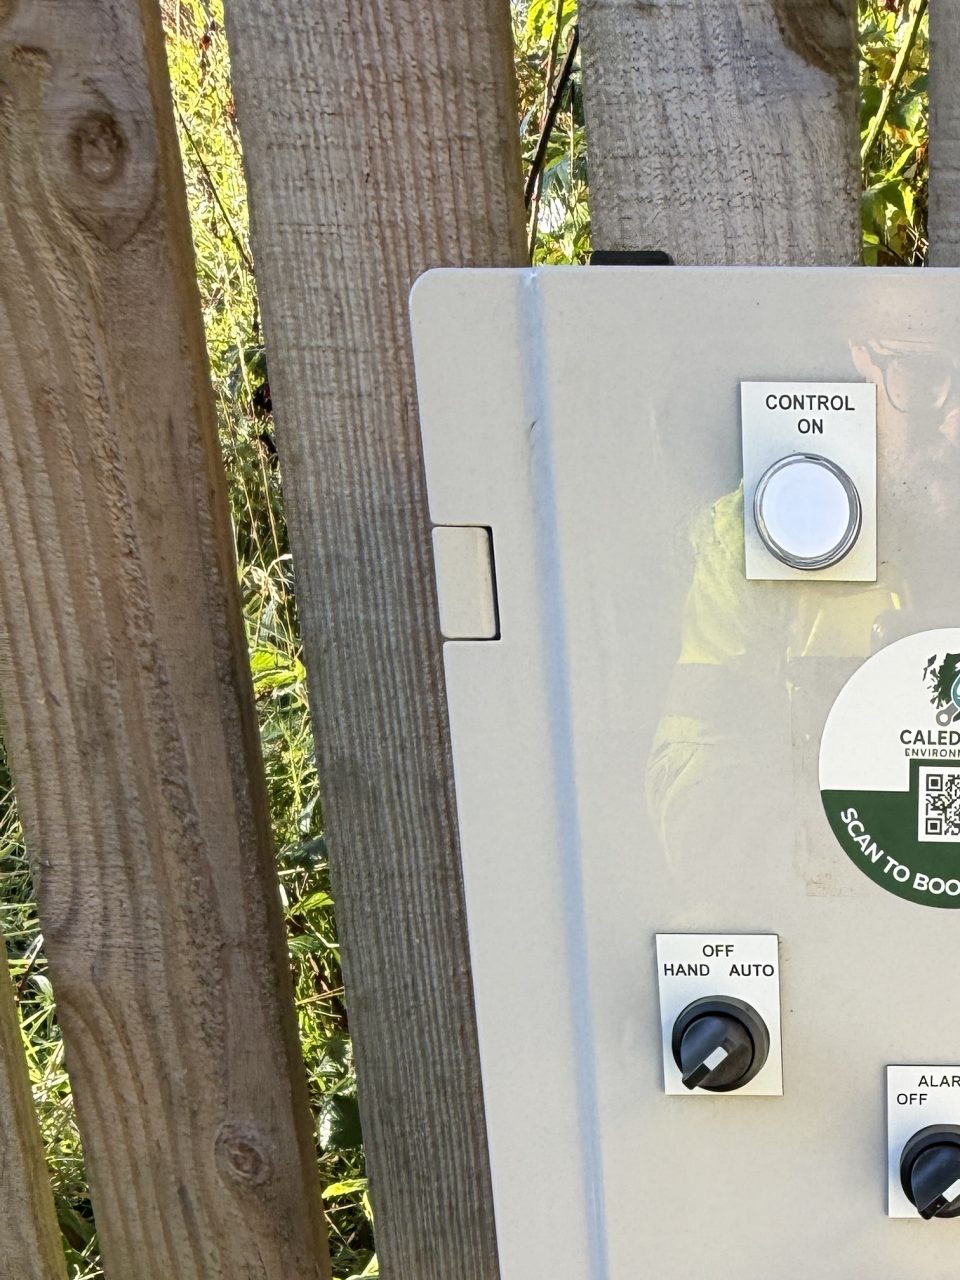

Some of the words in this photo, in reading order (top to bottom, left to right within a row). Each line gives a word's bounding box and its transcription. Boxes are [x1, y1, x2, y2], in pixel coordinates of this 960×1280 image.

[765, 394, 856, 411] CONTROL
[797, 418, 824, 435] ON
[840, 807, 885, 863] SCAN
[883, 856, 911, 883] TO
[702, 944, 734, 957] OFF
[663, 963, 710, 976] HAND
[729, 964, 775, 977] AUTO
[897, 1093, 928, 1105] OFF
